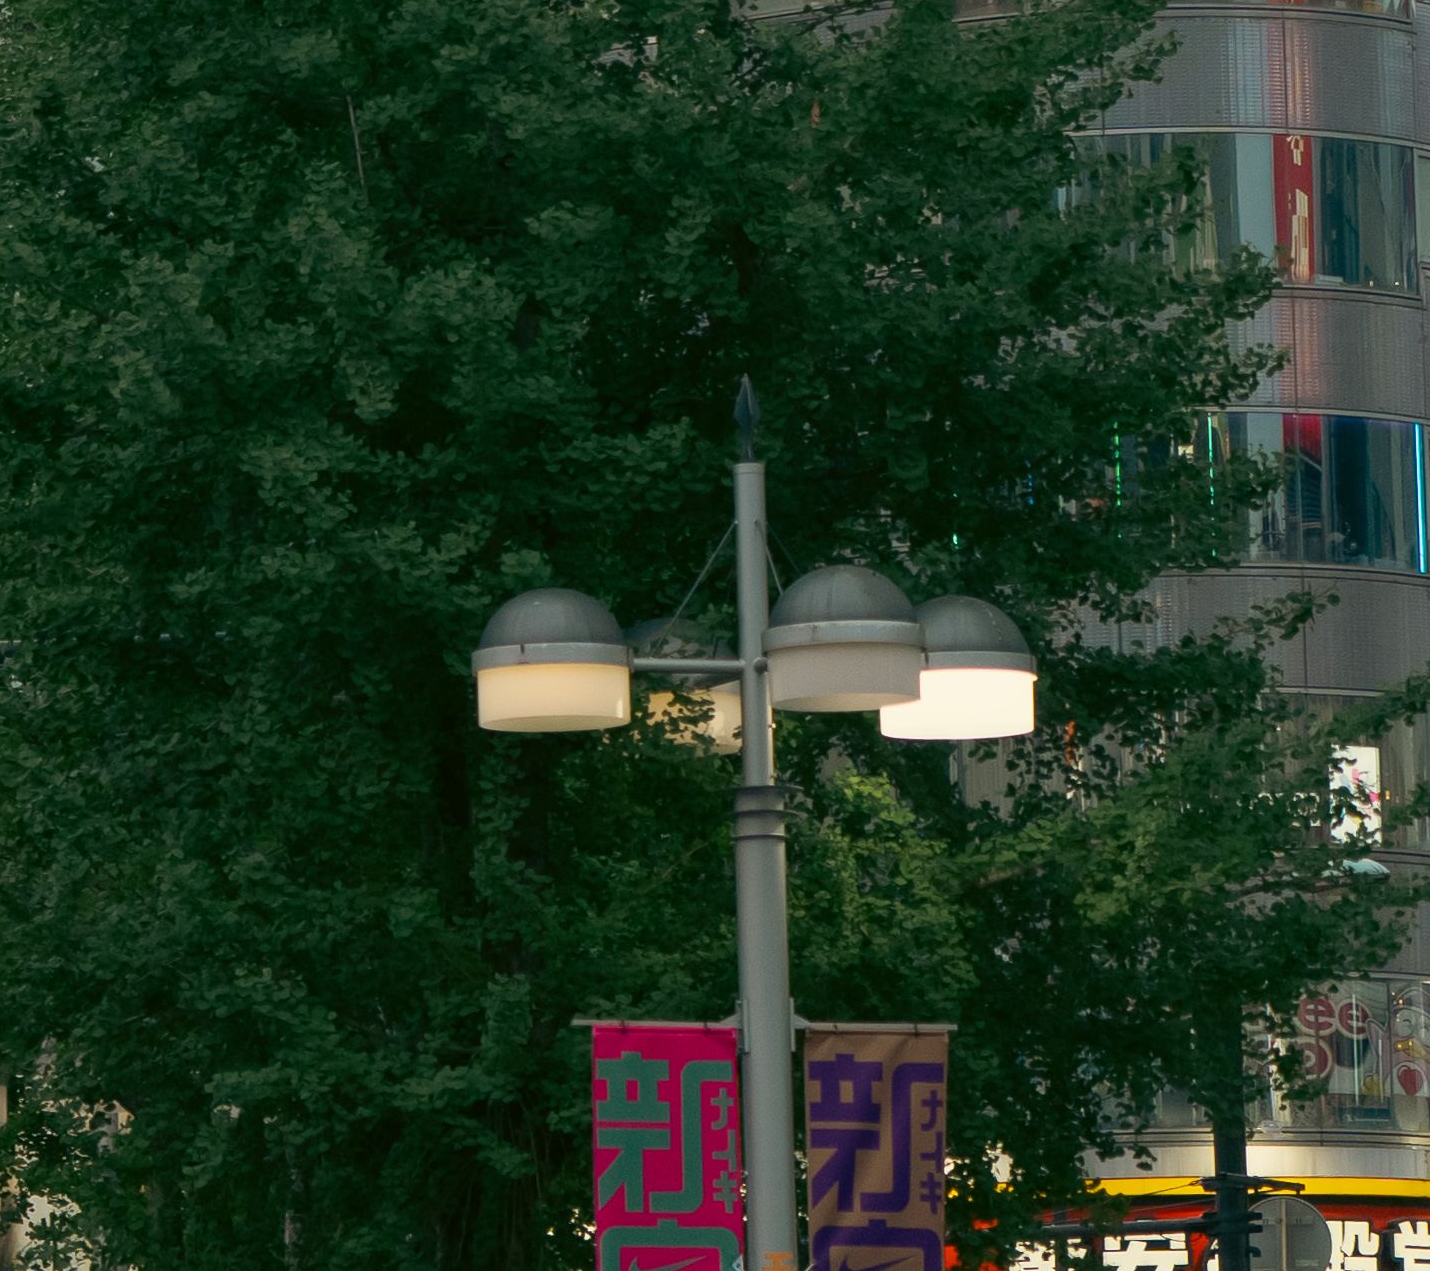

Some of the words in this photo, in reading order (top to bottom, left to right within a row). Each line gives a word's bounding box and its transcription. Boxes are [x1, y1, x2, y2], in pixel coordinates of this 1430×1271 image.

[711, 1087, 738, 1213] ナイキ
[919, 1089, 944, 1214] ナイキ
